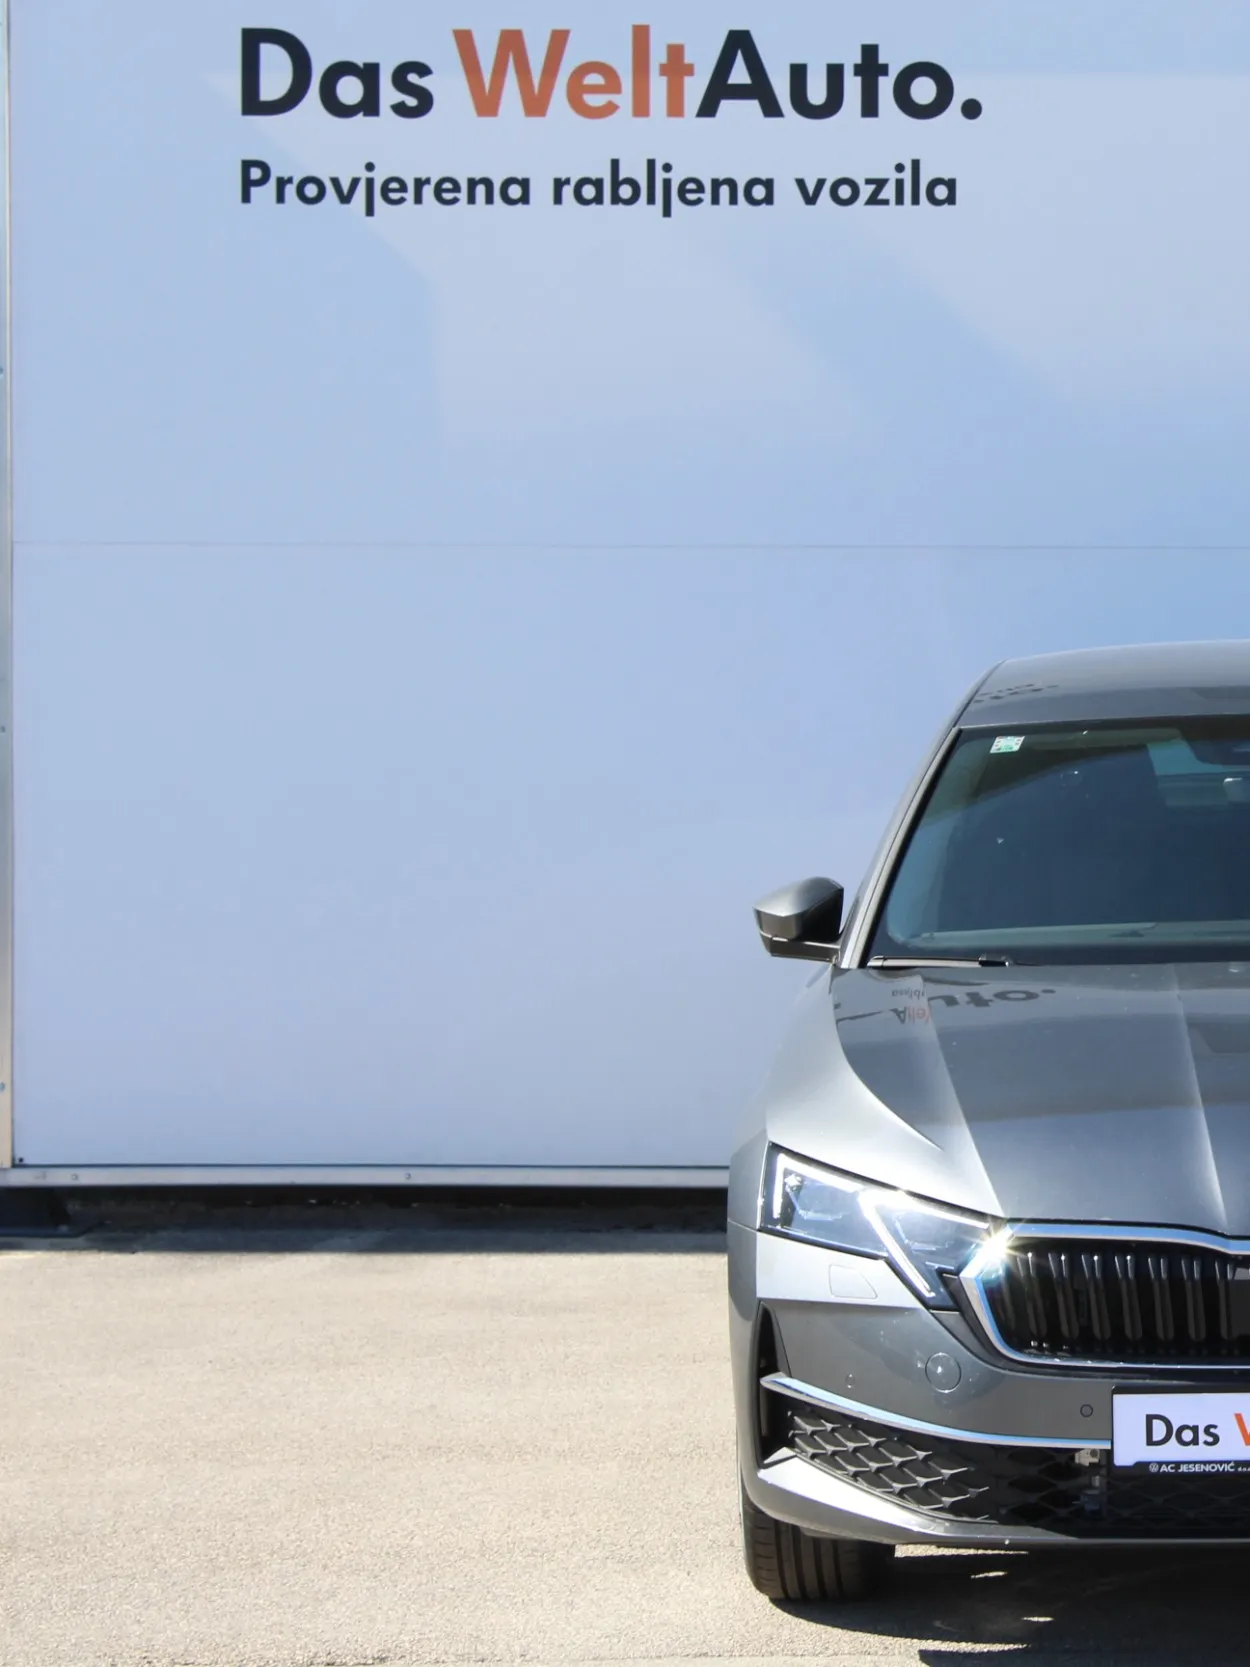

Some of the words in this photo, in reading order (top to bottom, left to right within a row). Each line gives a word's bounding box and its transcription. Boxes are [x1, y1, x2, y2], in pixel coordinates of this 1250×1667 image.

[240, 27, 434, 120] Das
[452, 24, 983, 121] WeltAuto.
[240, 158, 532, 218] Provjerena
[552, 158, 775, 219] rabljena
[794, 158, 958, 207] vozila
[1145, 1413, 1221, 1447] Das
[1160, 1463, 1176, 1473] AC
[1178, 1461, 1236, 1473] JESENOVIĆ
